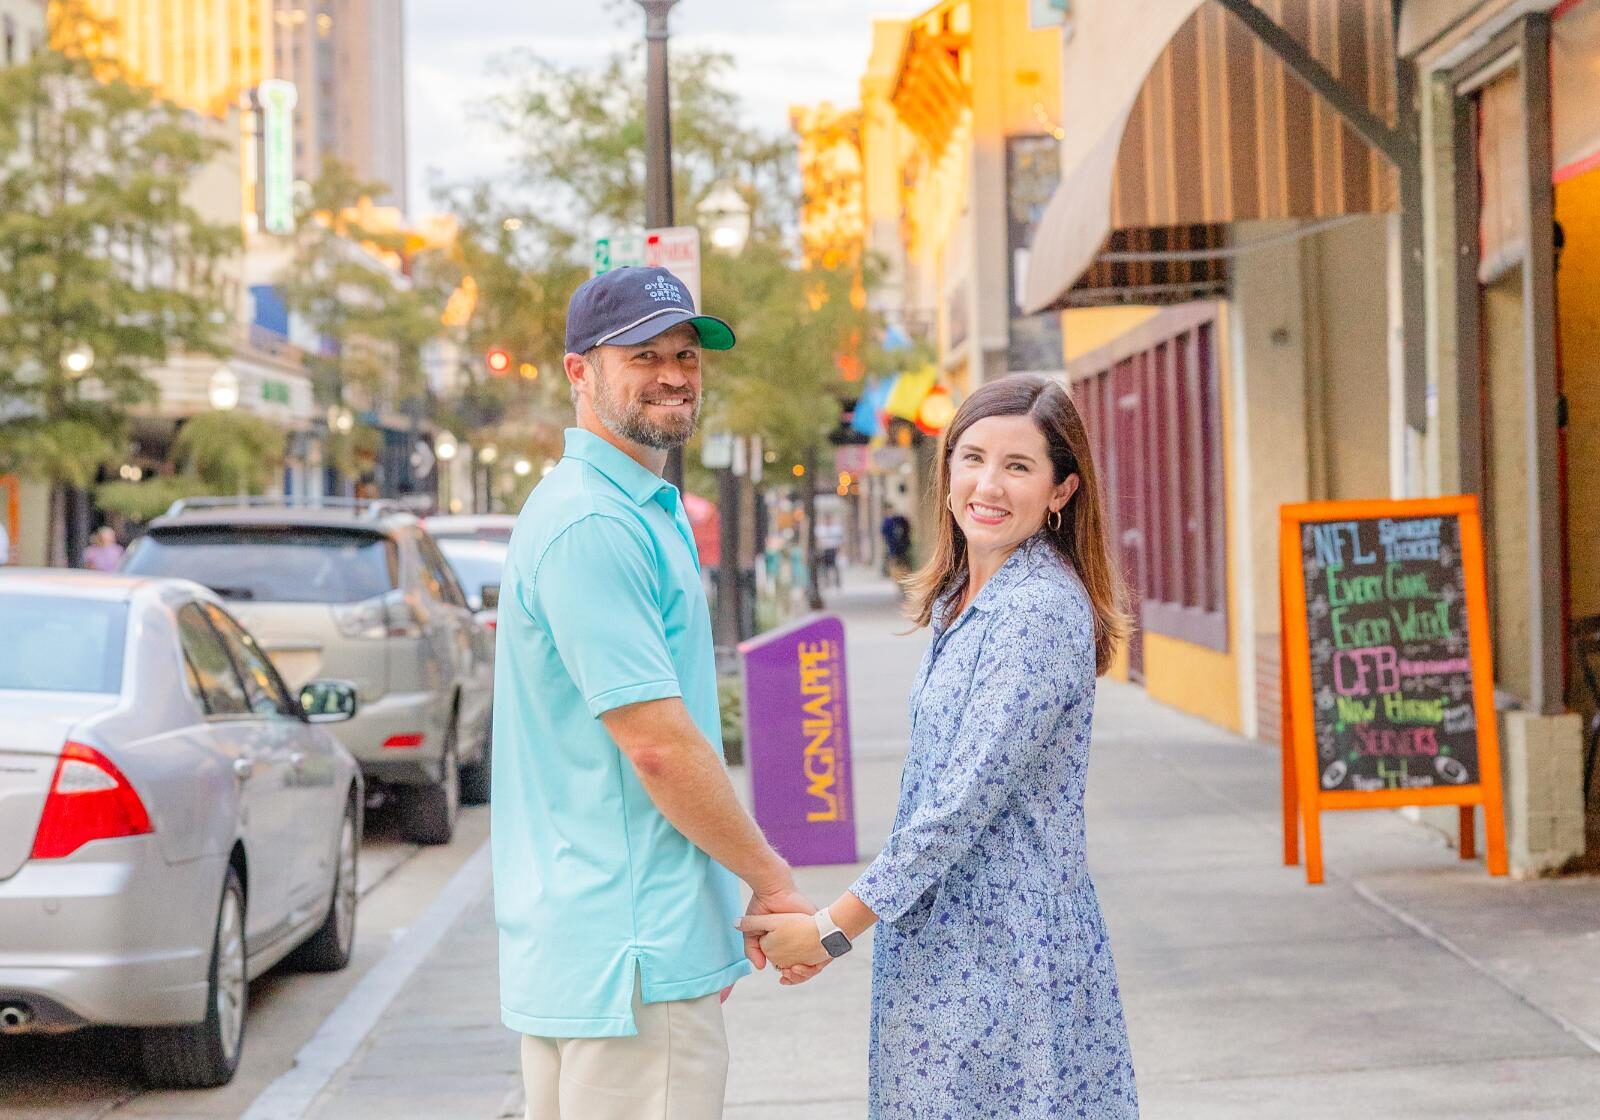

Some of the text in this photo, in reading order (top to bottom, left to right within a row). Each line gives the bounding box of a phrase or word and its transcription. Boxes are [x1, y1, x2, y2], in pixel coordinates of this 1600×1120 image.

[645, 281, 679, 293] OYSTER
[1313, 520, 1376, 569] NFL
[1333, 645, 1400, 696] CFB
[798, 638, 838, 822] LAGNIAPPE
